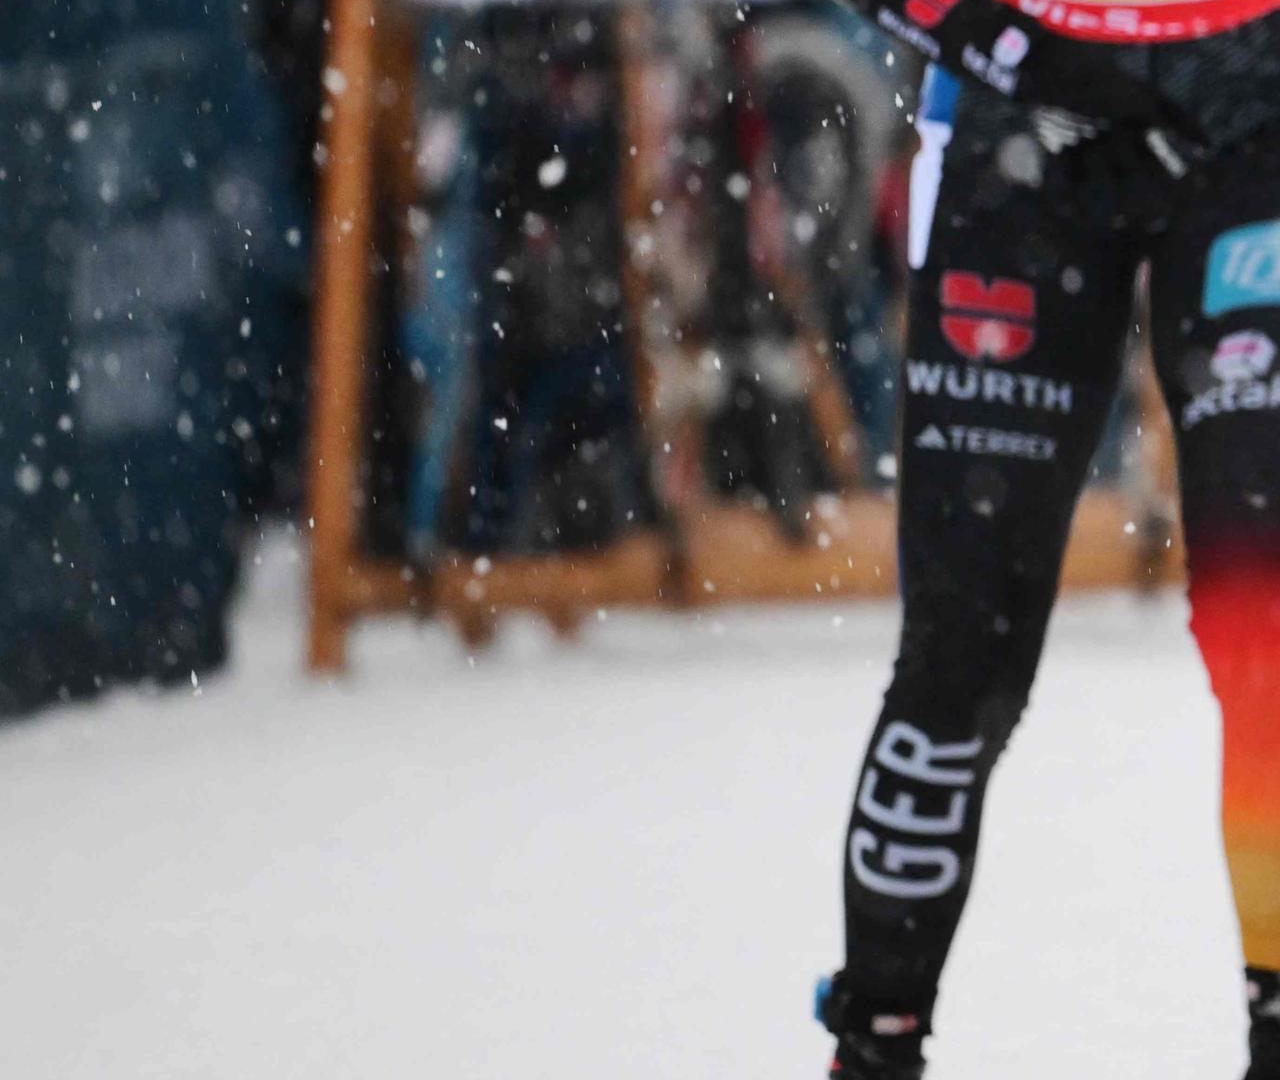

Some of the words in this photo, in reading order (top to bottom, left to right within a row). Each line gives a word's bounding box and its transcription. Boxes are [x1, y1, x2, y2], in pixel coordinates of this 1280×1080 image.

[907, 357, 1073, 414] WÜRTH
[949, 424, 1057, 461] TERREX
[850, 720, 984, 899] GER
